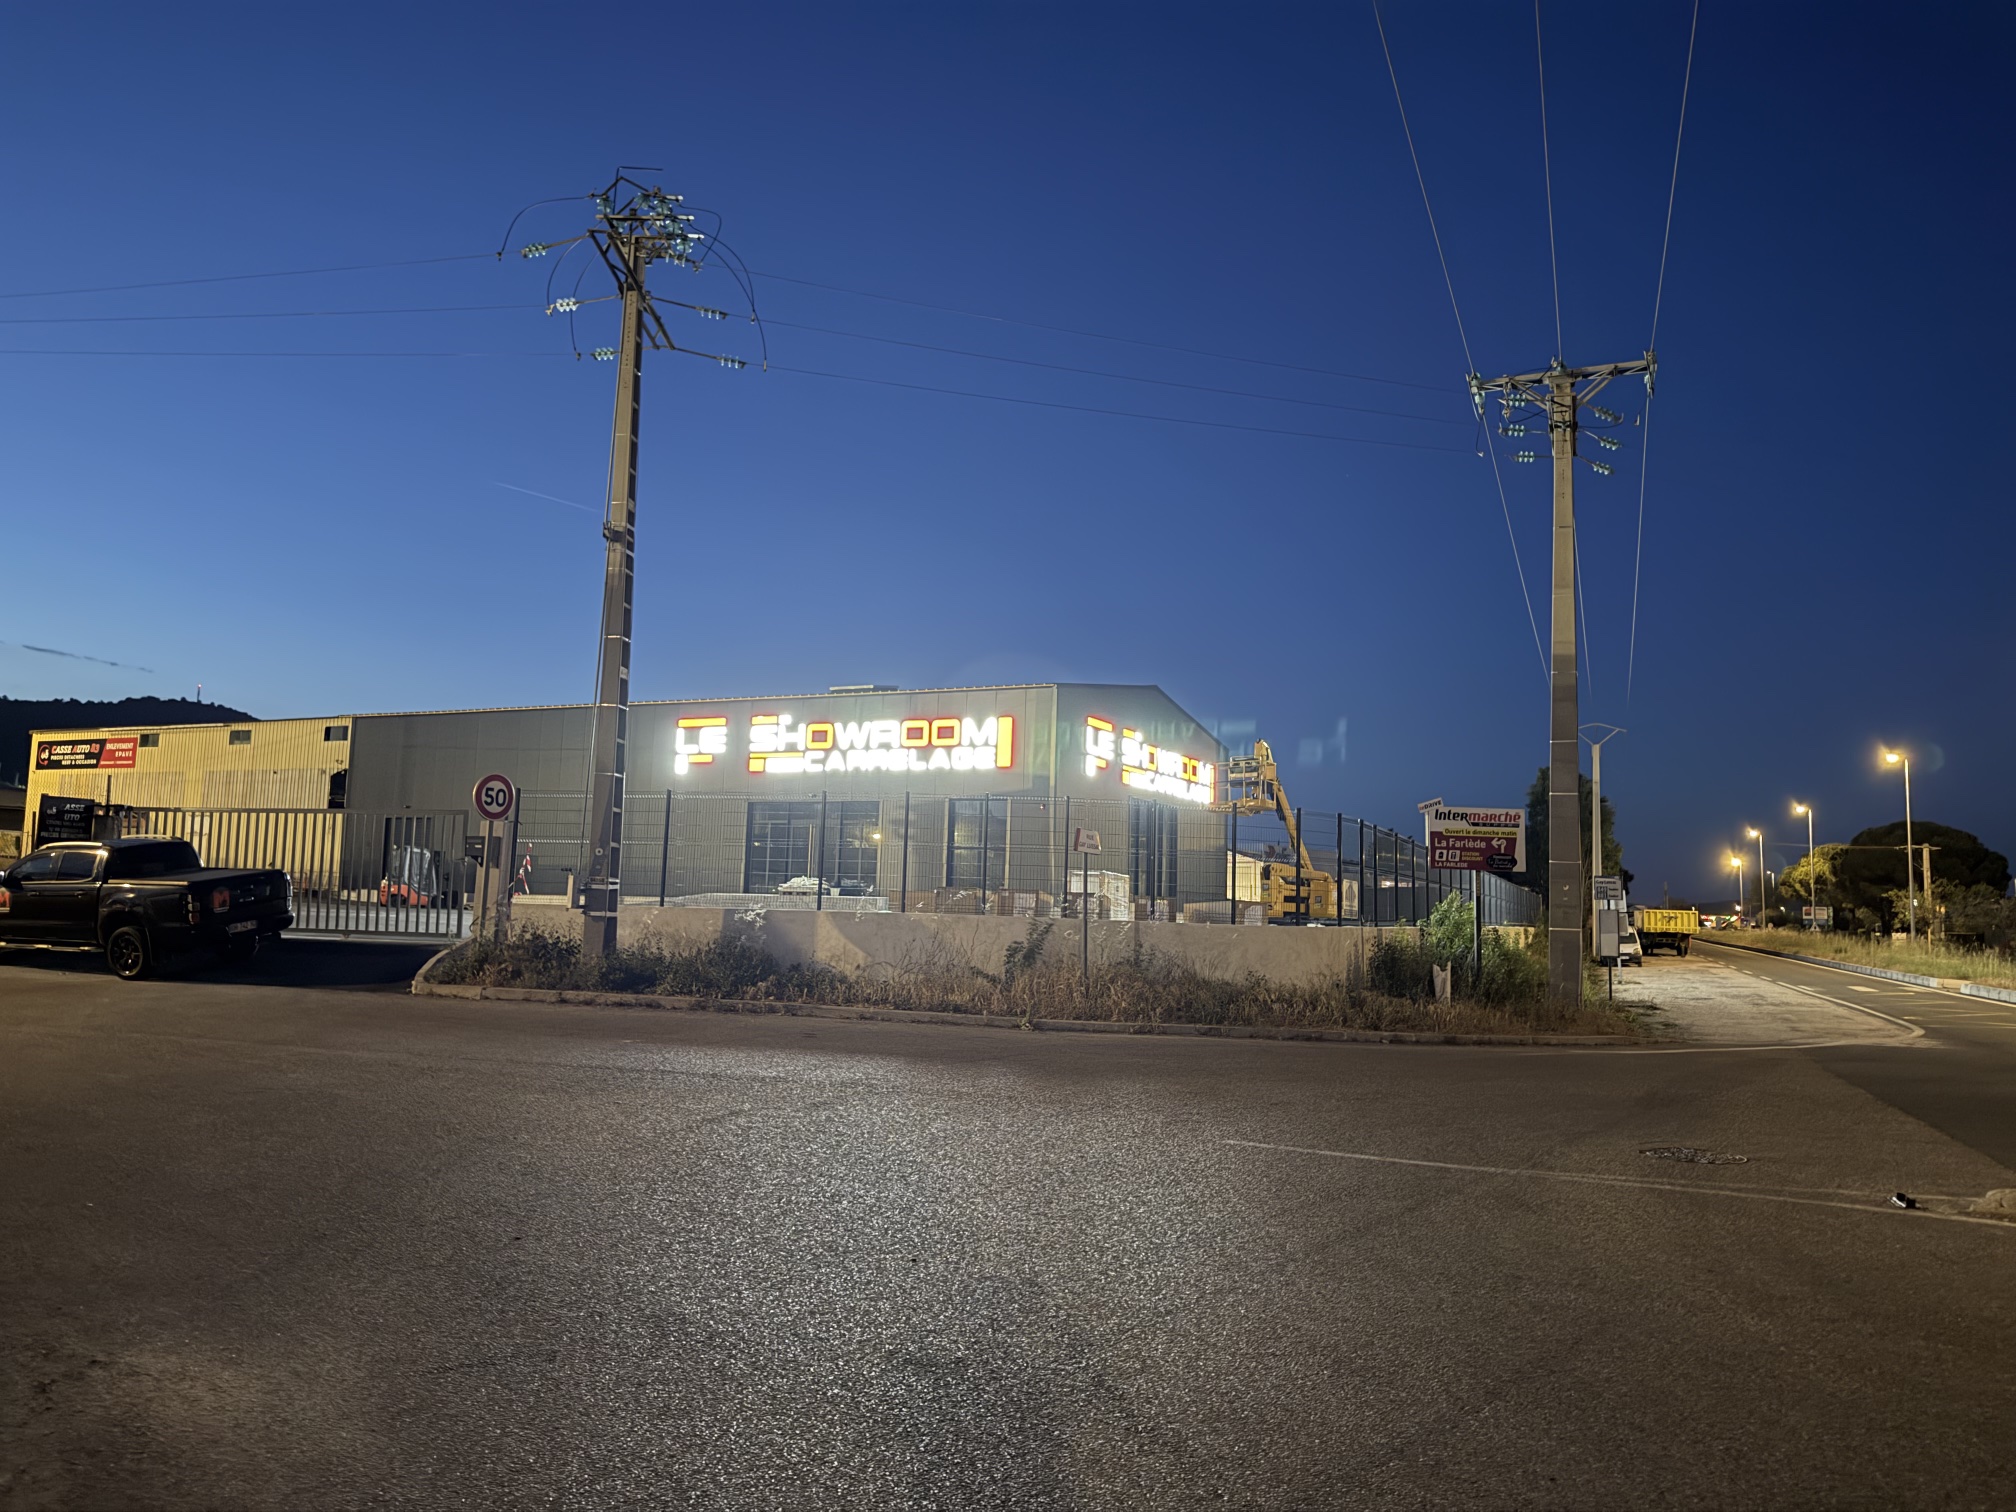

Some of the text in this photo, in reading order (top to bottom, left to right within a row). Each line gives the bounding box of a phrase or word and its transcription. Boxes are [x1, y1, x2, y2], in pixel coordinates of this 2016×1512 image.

[676, 717, 998, 754] LE SHOWROOM
[1086, 726, 1116, 760] LE
[51, 745, 73, 754] CASSE
[72, 744, 91, 753] AUTO
[804, 747, 996, 773] CARRELAGE
[484, 788, 506, 807] 50
[1435, 809, 1521, 825] Intermarché
[1435, 838, 1487, 849] La Farlède
